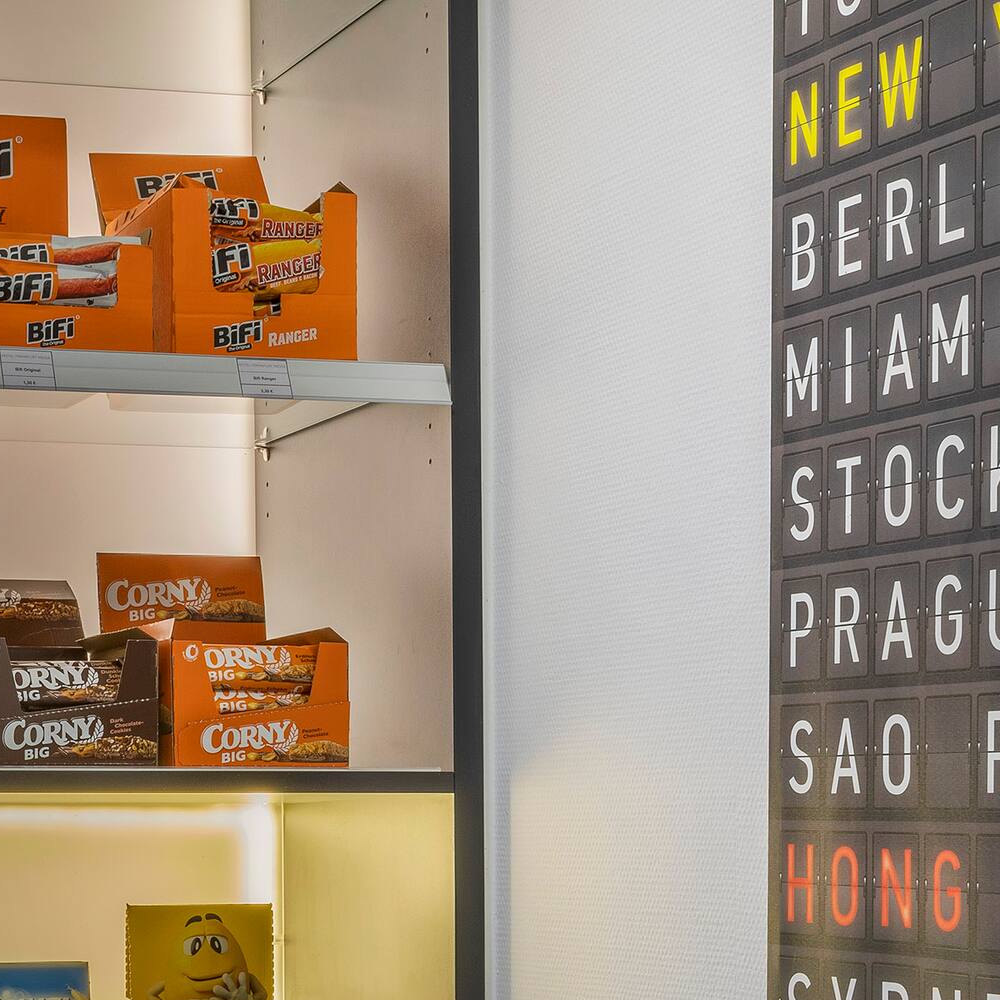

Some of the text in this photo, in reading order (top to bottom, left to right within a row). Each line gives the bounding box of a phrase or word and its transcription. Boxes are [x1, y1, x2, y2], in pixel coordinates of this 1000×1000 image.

[790, 36, 922, 166] NEW
[27, 316, 76, 344] BiFi
[213, 319, 263, 350] BiFi
[268, 327, 318, 347] RANGER
[106, 577, 202, 612] CORNY
[129, 608, 156, 622] BIG
[208, 670, 236, 682] BIG
[220, 700, 248, 713] BIG
[2, 715, 98, 751] CORNY
[109, 727, 132, 735] Cookies
[201, 719, 291, 754] CORNY
[24, 747, 50, 760] BIG
[221, 750, 246, 764] BIG
[789, 713, 912, 796] SAO
[786, 843, 962, 933] HONG
